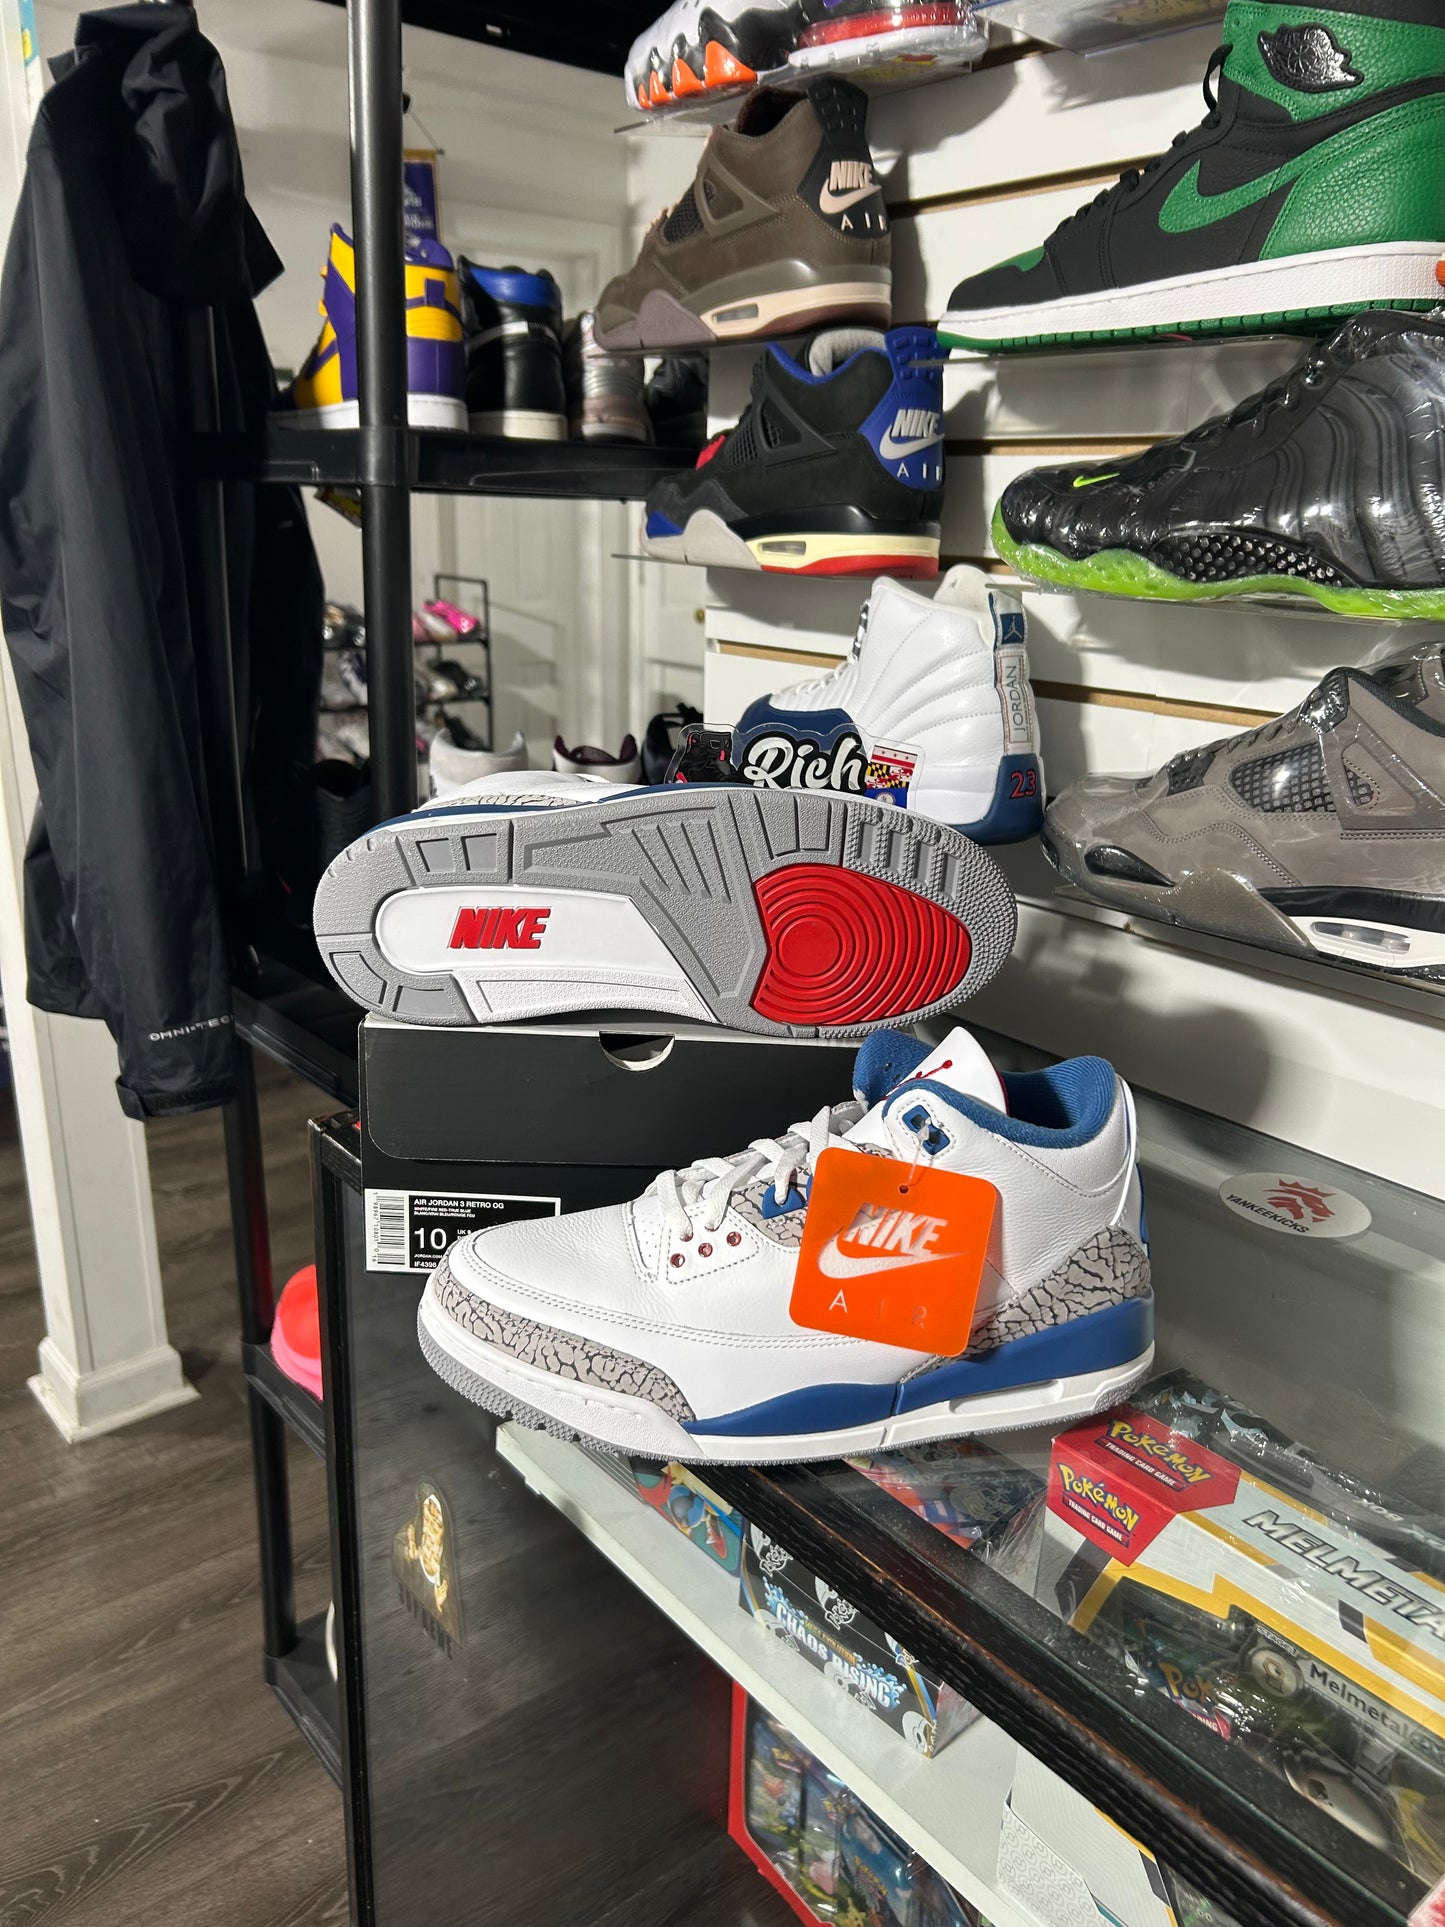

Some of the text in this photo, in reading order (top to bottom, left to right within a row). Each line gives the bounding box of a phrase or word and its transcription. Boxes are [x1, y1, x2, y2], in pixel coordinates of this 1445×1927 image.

[829, 161, 873, 191] NIKE
[891, 408, 940, 438] NIKE
[1005, 665, 1026, 732] JORDAN
[743, 736, 861, 790] Rich
[1010, 770, 1037, 799] 23
[447, 906, 552, 949] NIKE
[149, 1014, 233, 1041] OMNI-TEC
[428, 1199, 459, 1207] JORDAN
[466, 1201, 491, 1209] RETRO
[1226, 1193, 1310, 1233] YANKEEKICKS
[414, 1227, 447, 1249] 10
[842, 1202, 948, 1256] NIKE
[829, 1288, 928, 1329] AIR
[1105, 1442, 1177, 1487] TRADING CARD GAME
[1068, 1499, 1123, 1542] TRADING CARD GAME
[776, 1602, 828, 1660] CHAOS
[831, 1653, 891, 1708] RISING
[1310, 1663, 1408, 1738] Melmetal
